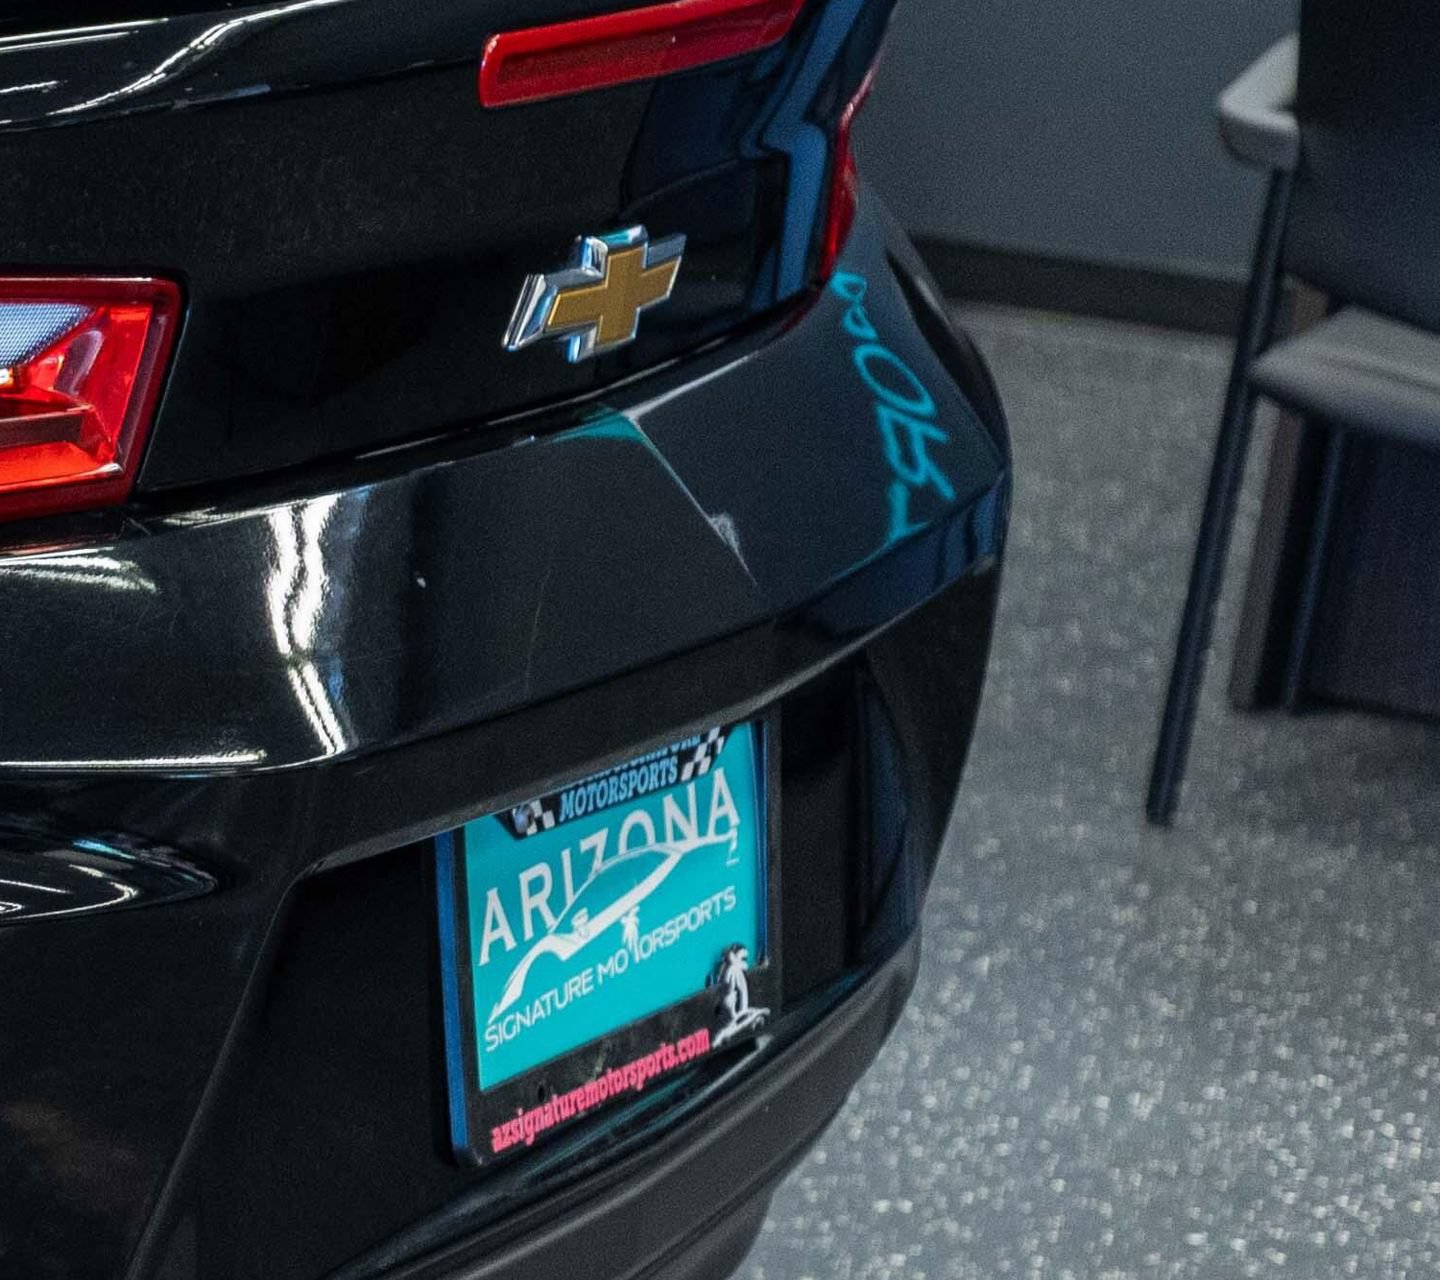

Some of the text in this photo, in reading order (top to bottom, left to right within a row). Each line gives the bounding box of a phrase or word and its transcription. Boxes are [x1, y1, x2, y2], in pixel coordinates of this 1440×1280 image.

[559, 754, 679, 823] MOTORSPORTS
[479, 766, 740, 967] ARIZONA
[483, 967, 594, 1053] SIGNATURE
[490, 1027, 711, 1155] azsignaturemotorsports.com
